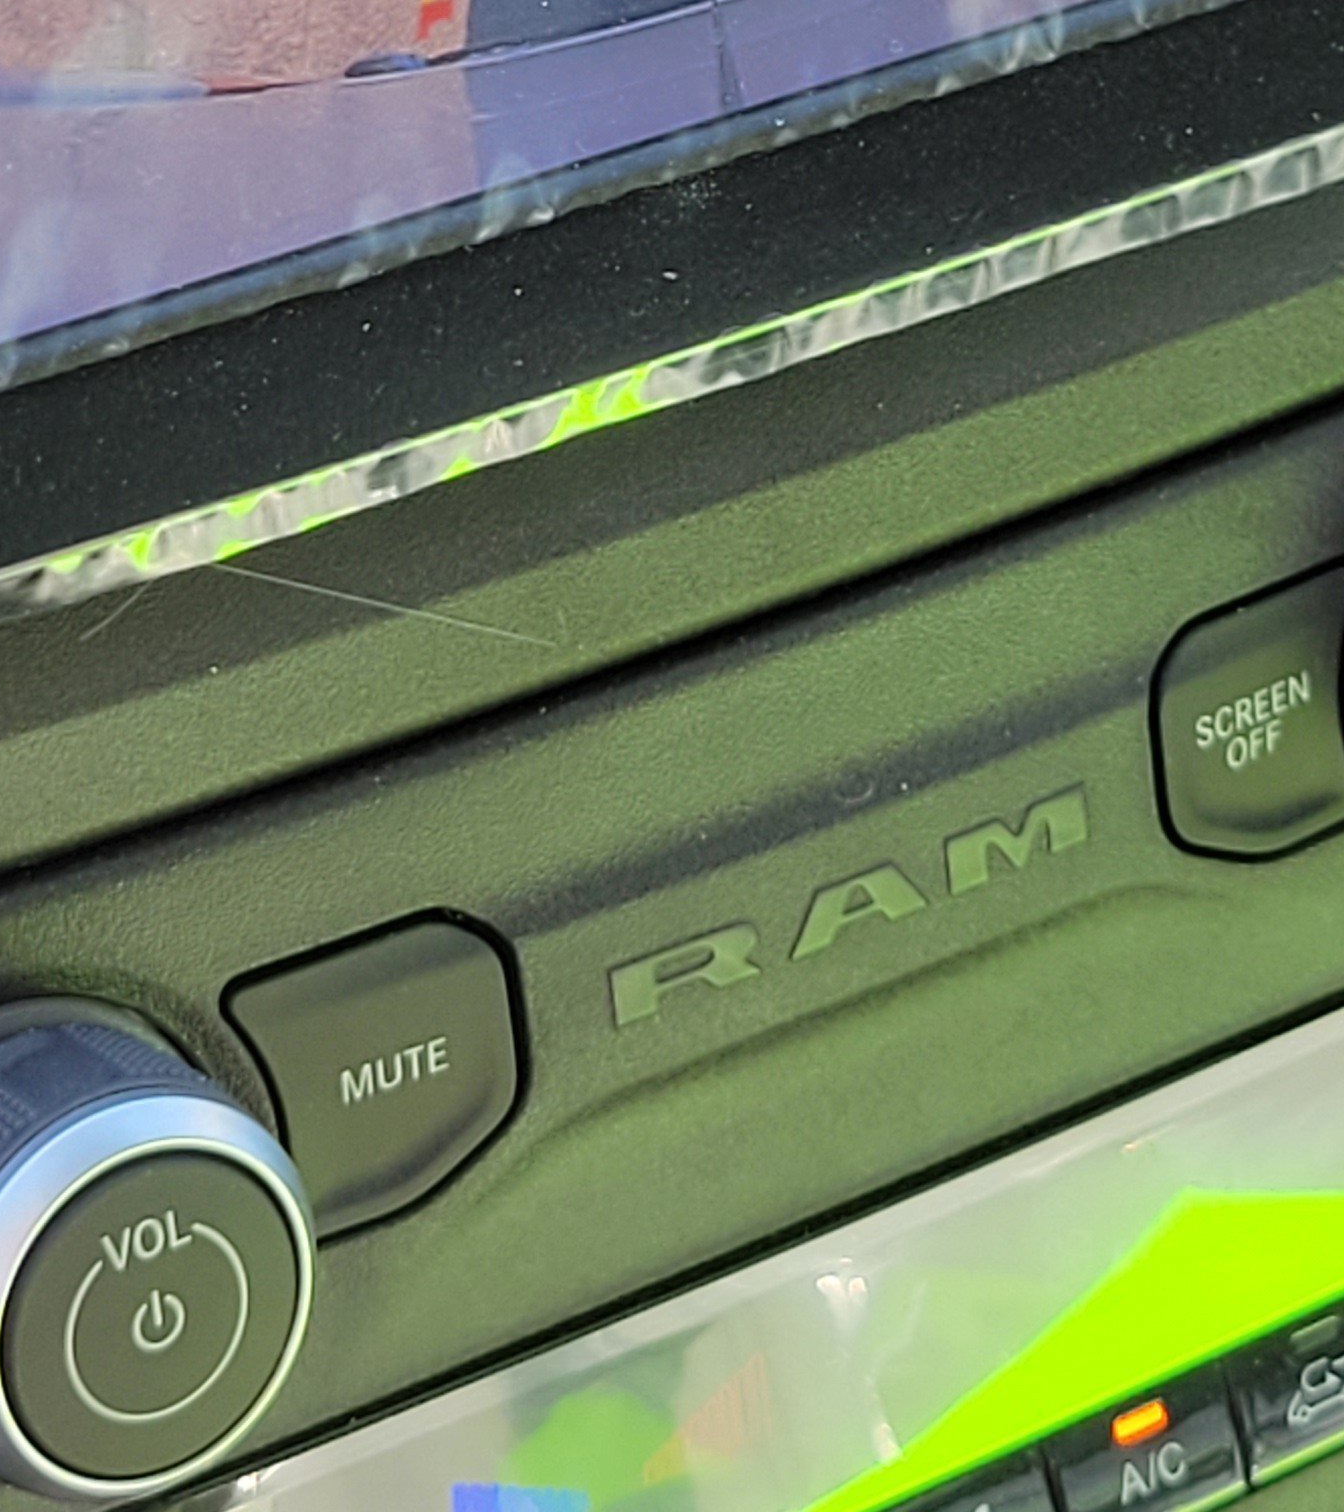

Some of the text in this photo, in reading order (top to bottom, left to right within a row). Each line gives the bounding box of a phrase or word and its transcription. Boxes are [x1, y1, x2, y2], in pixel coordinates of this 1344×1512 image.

[1194, 670, 1310, 749] SCREEN
[1224, 720, 1282, 771] OFF
[607, 782, 1089, 1028] RAM
[339, 1036, 451, 1105] MUTE
[101, 1210, 193, 1273] VOL
[1120, 1441, 1186, 1505] A/C
